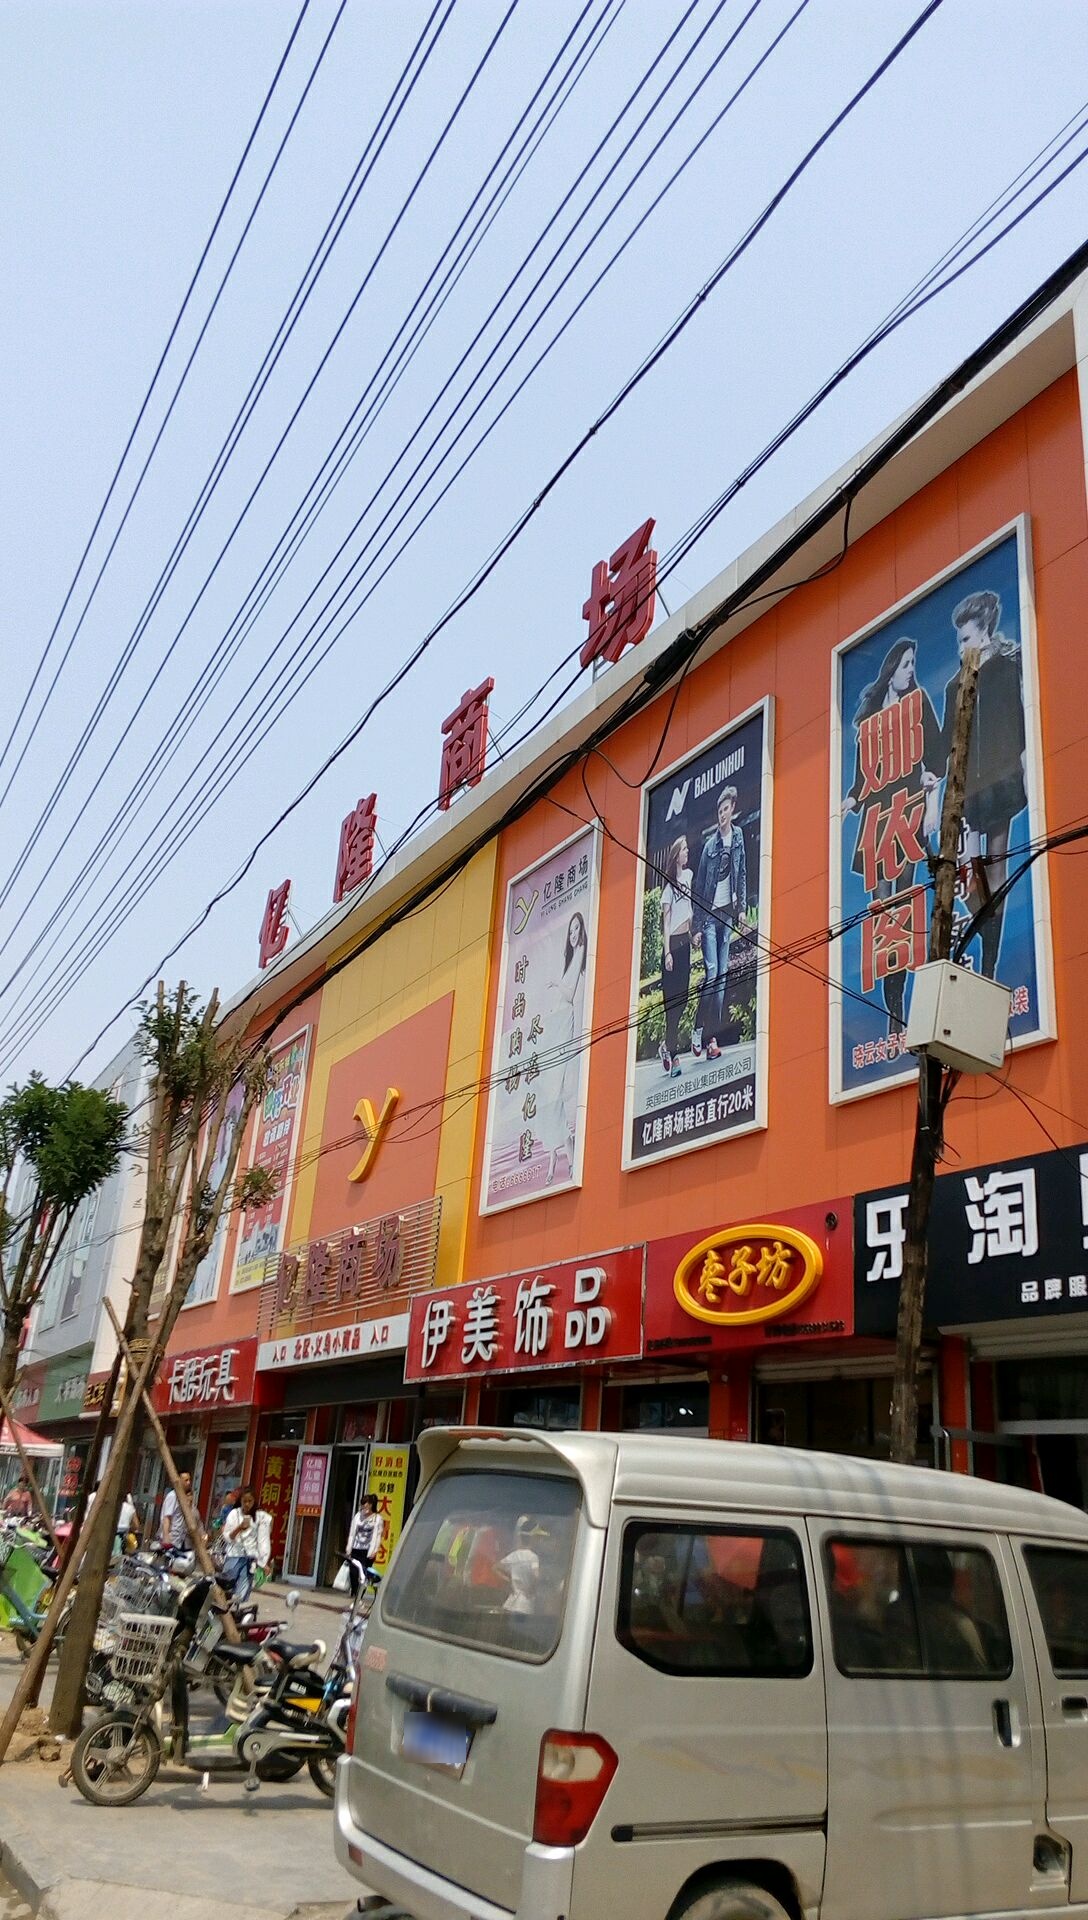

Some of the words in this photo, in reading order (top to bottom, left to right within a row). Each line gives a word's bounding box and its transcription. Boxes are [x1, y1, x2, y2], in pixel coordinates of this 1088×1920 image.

[258, 517, 658, 969] 亿隆商场
[694, 745, 745, 799] BAILUNHUI
[543, 854, 589, 902] 亿隆商场
[858, 688, 928, 994] 娜依阁
[641, 1084, 754, 1146] 亿隆商场鞋区直行20米
[275, 1214, 402, 1312] 亿隆商场
[421, 1266, 613, 1369] 伊美饰品
[168, 1349, 240, 1406] 卡酷玩具
